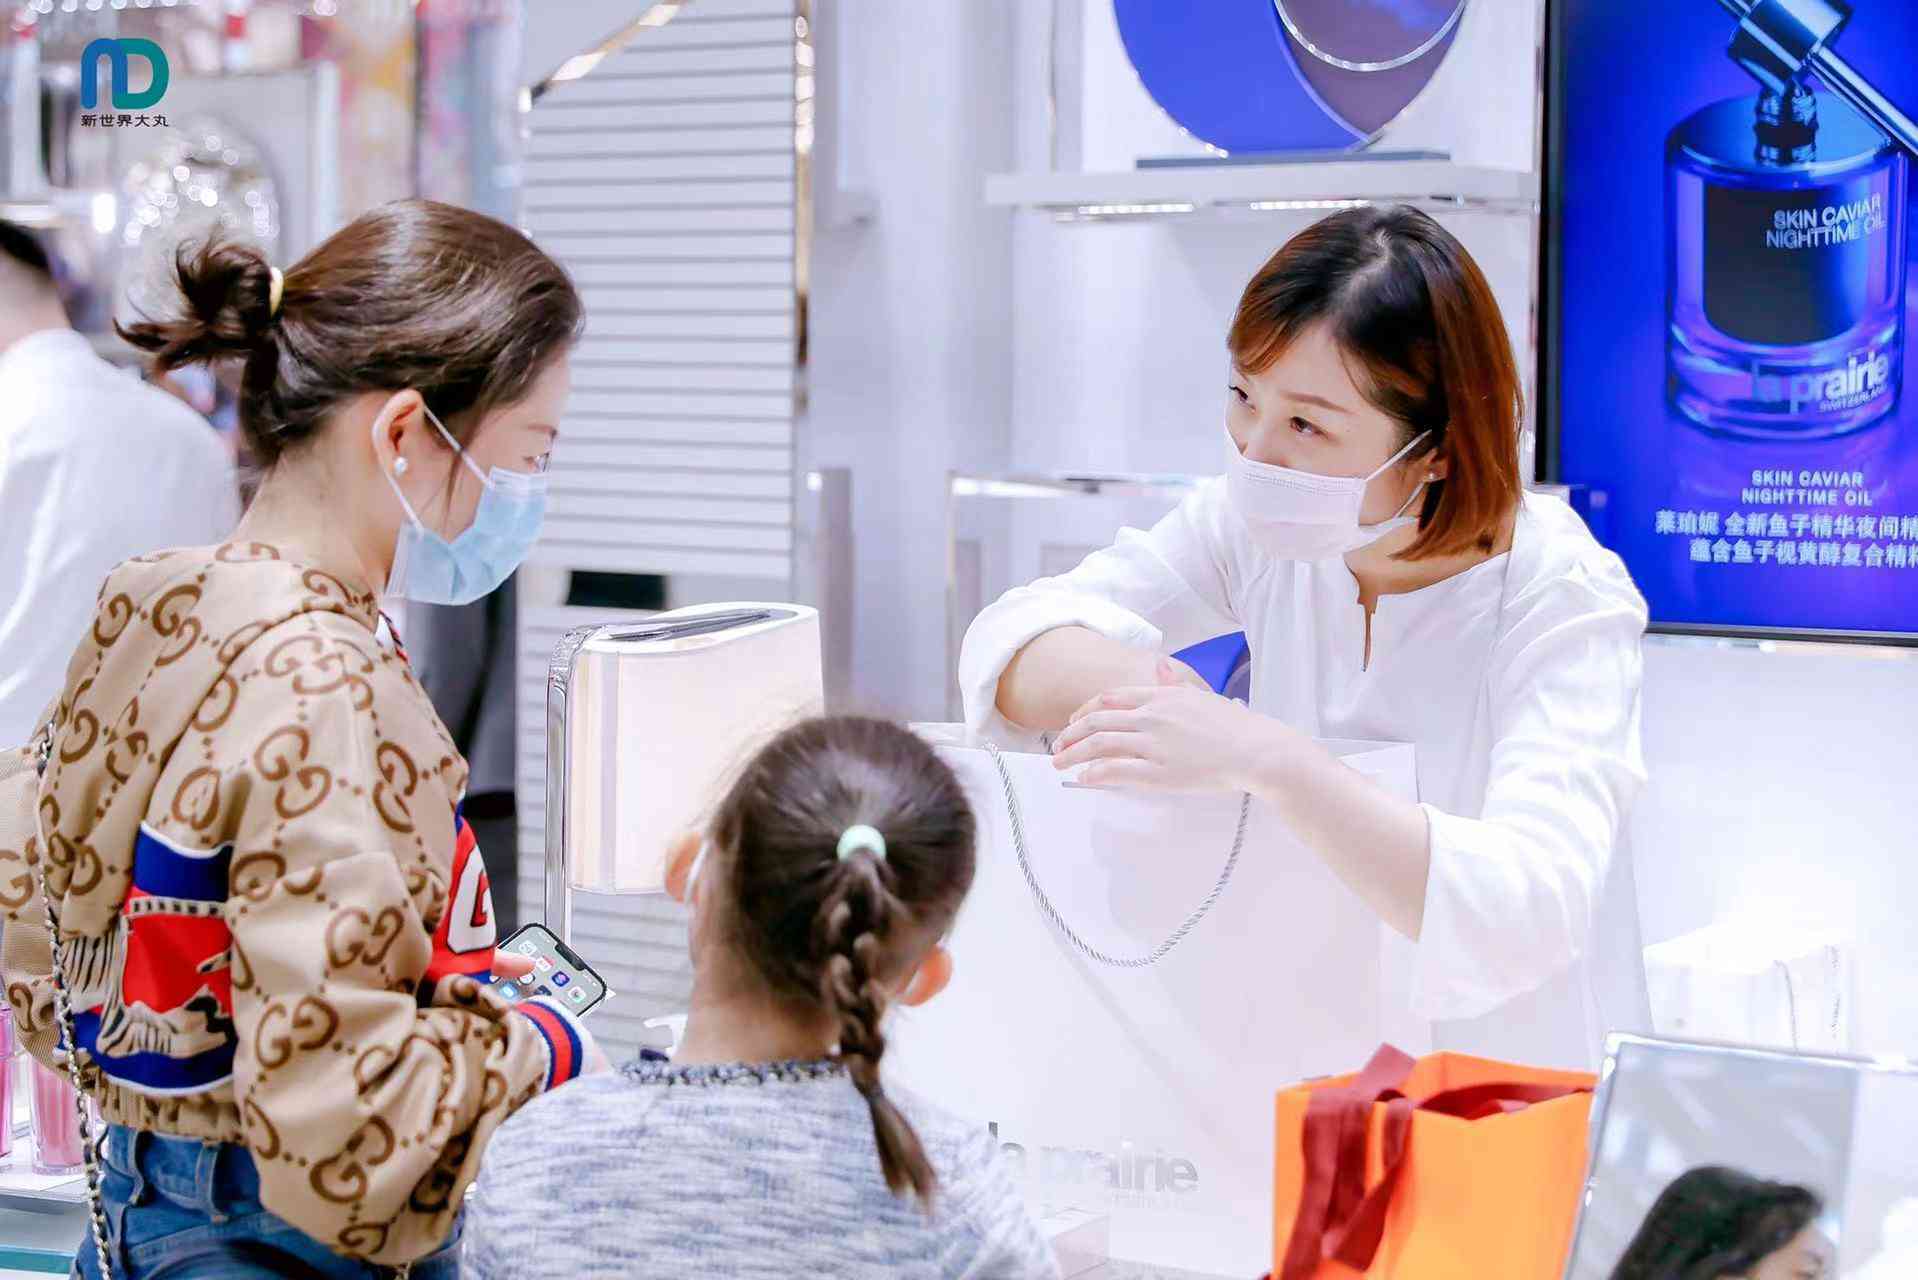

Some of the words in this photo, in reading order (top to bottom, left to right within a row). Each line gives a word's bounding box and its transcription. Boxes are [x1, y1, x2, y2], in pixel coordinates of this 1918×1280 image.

[1773, 208, 1818, 230] SKIN
[1821, 192, 1882, 228] CAVIAR
[1765, 219, 1860, 250] NIGHTTIME
[1863, 213, 1887, 235] OIL
[1789, 350, 1890, 415] prairie
[1741, 488, 1839, 506] NIGHTTIME
[1844, 491, 1873, 507] OIL
[1751, 470, 1793, 487] SKIN
[1799, 471, 1864, 488] CAVIAR
